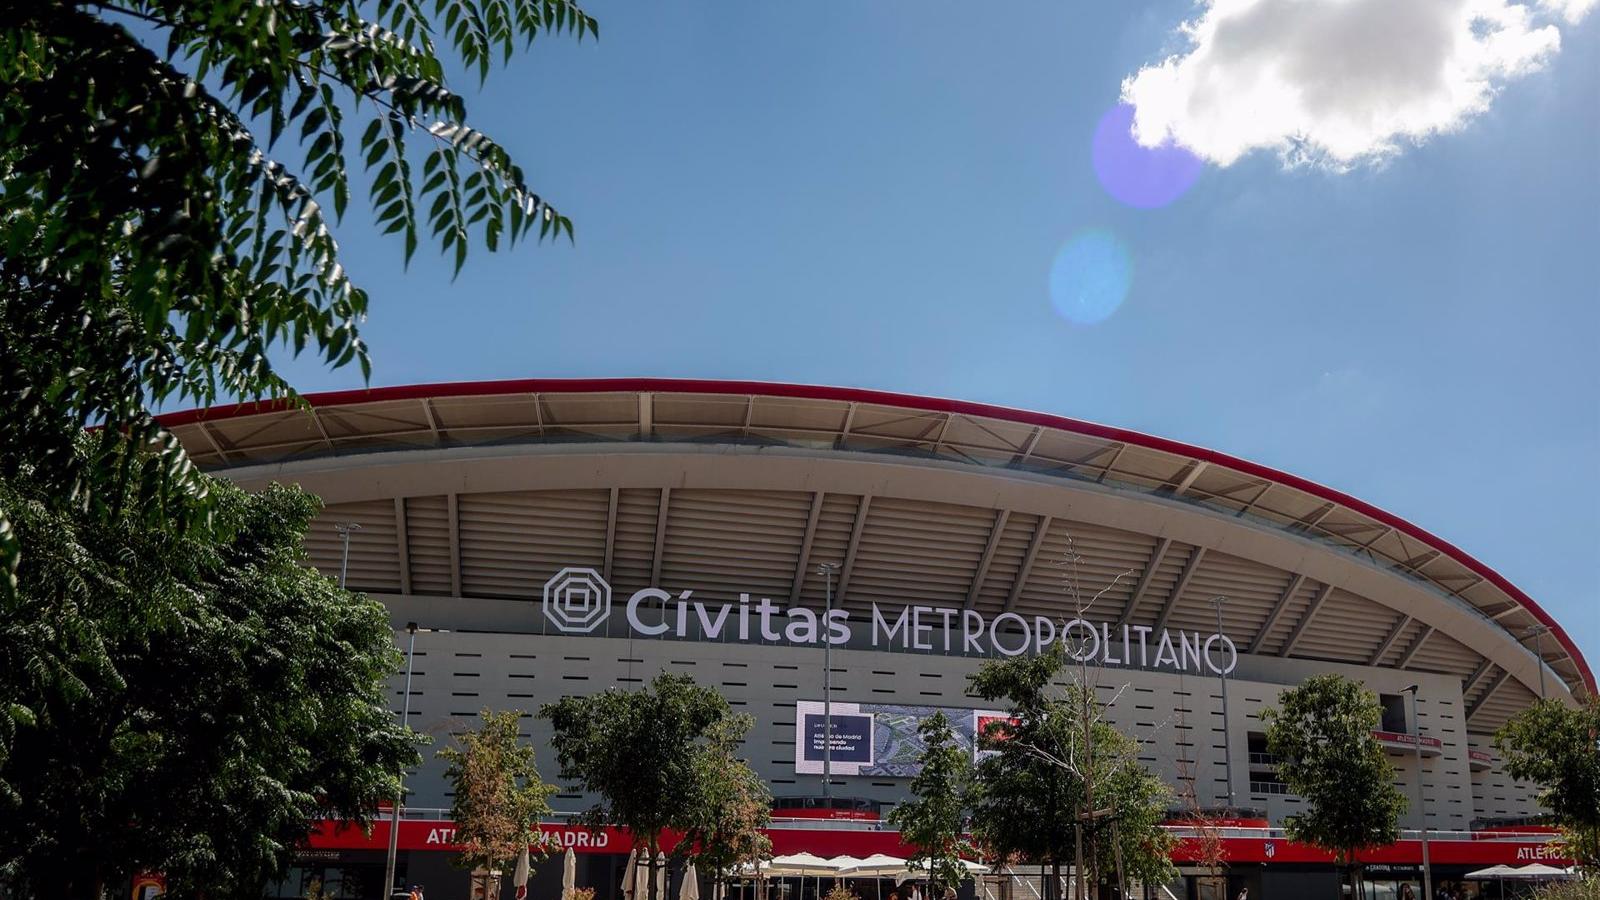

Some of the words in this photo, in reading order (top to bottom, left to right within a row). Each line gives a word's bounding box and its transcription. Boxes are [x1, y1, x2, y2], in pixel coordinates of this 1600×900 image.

[626, 587, 852, 645] Cívitas
[871, 600, 1239, 675] METROPOLITANO
[538, 831, 608, 848] MADRID
